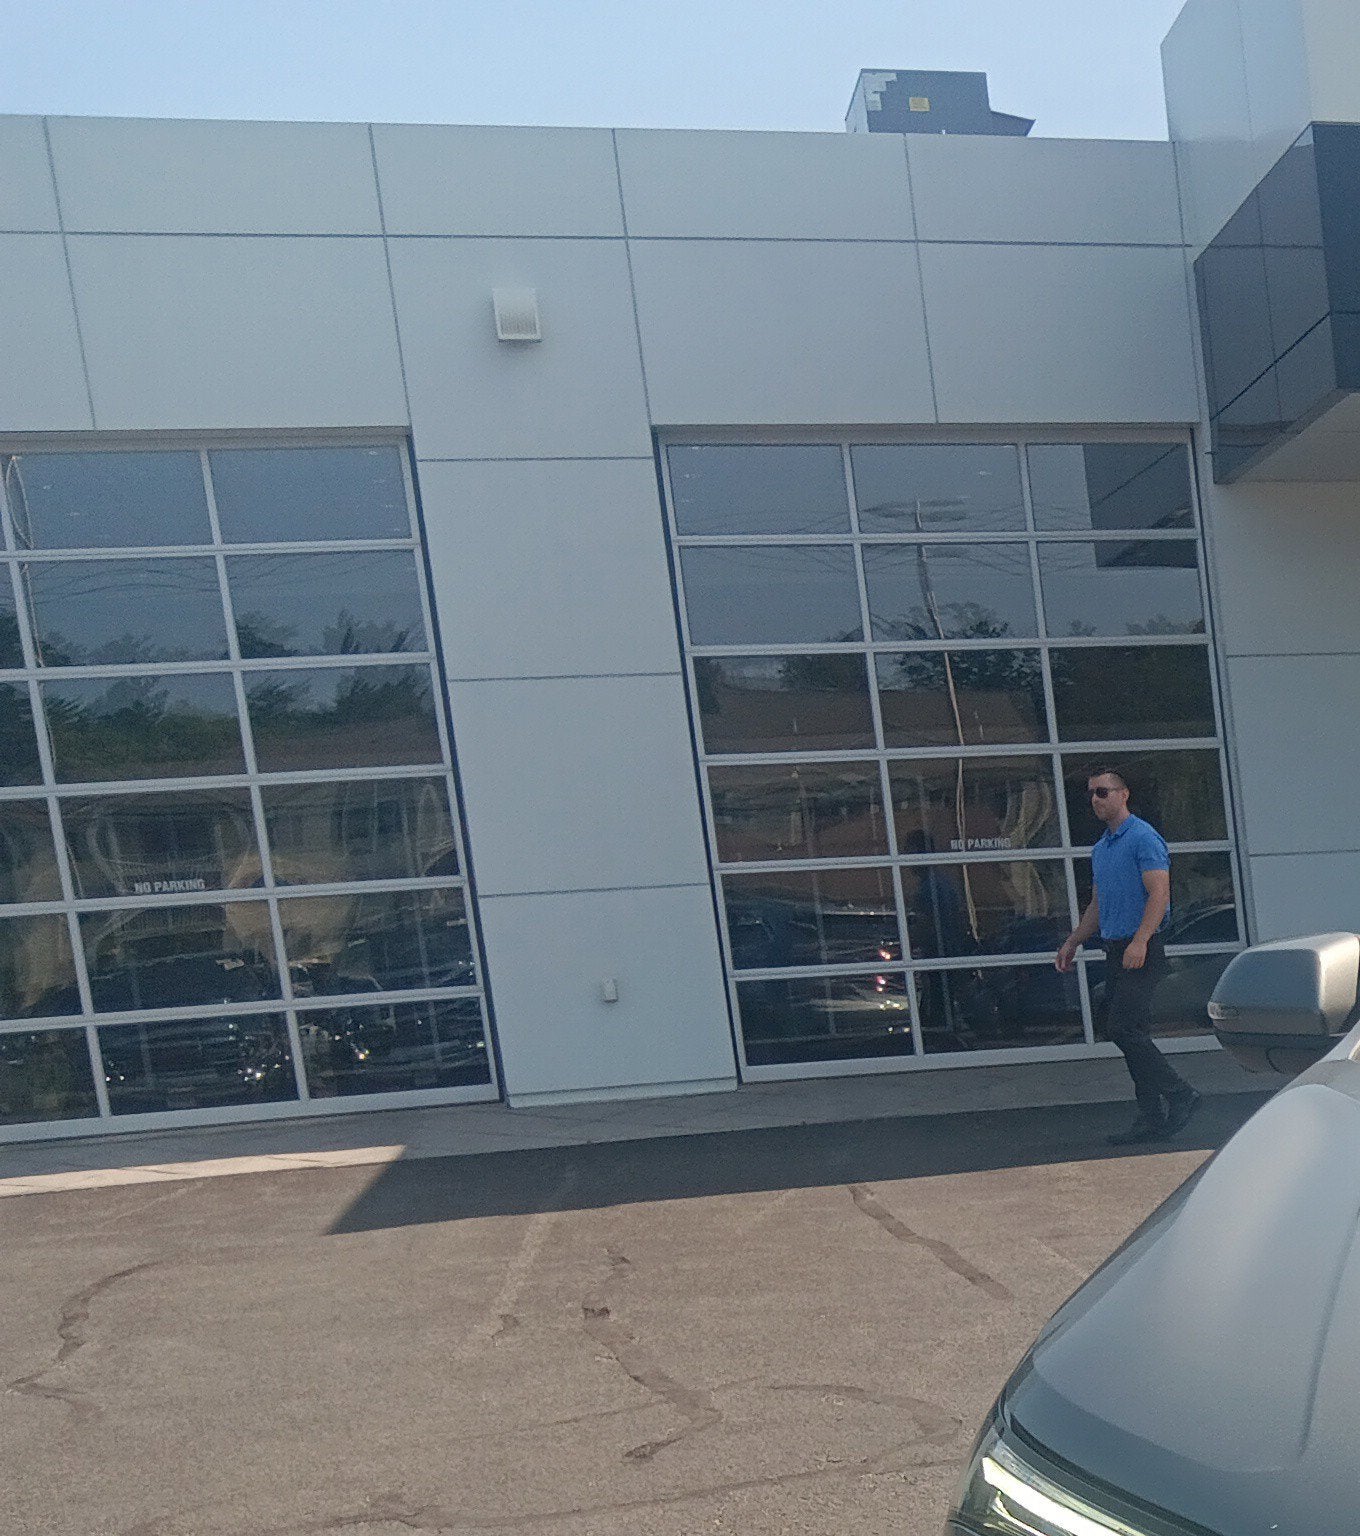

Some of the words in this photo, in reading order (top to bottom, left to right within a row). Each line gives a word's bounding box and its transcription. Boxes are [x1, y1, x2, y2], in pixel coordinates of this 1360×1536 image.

[967, 837, 1012, 850] PARKING
[134, 881, 152, 894] NO
[154, 878, 206, 893] PARKING
